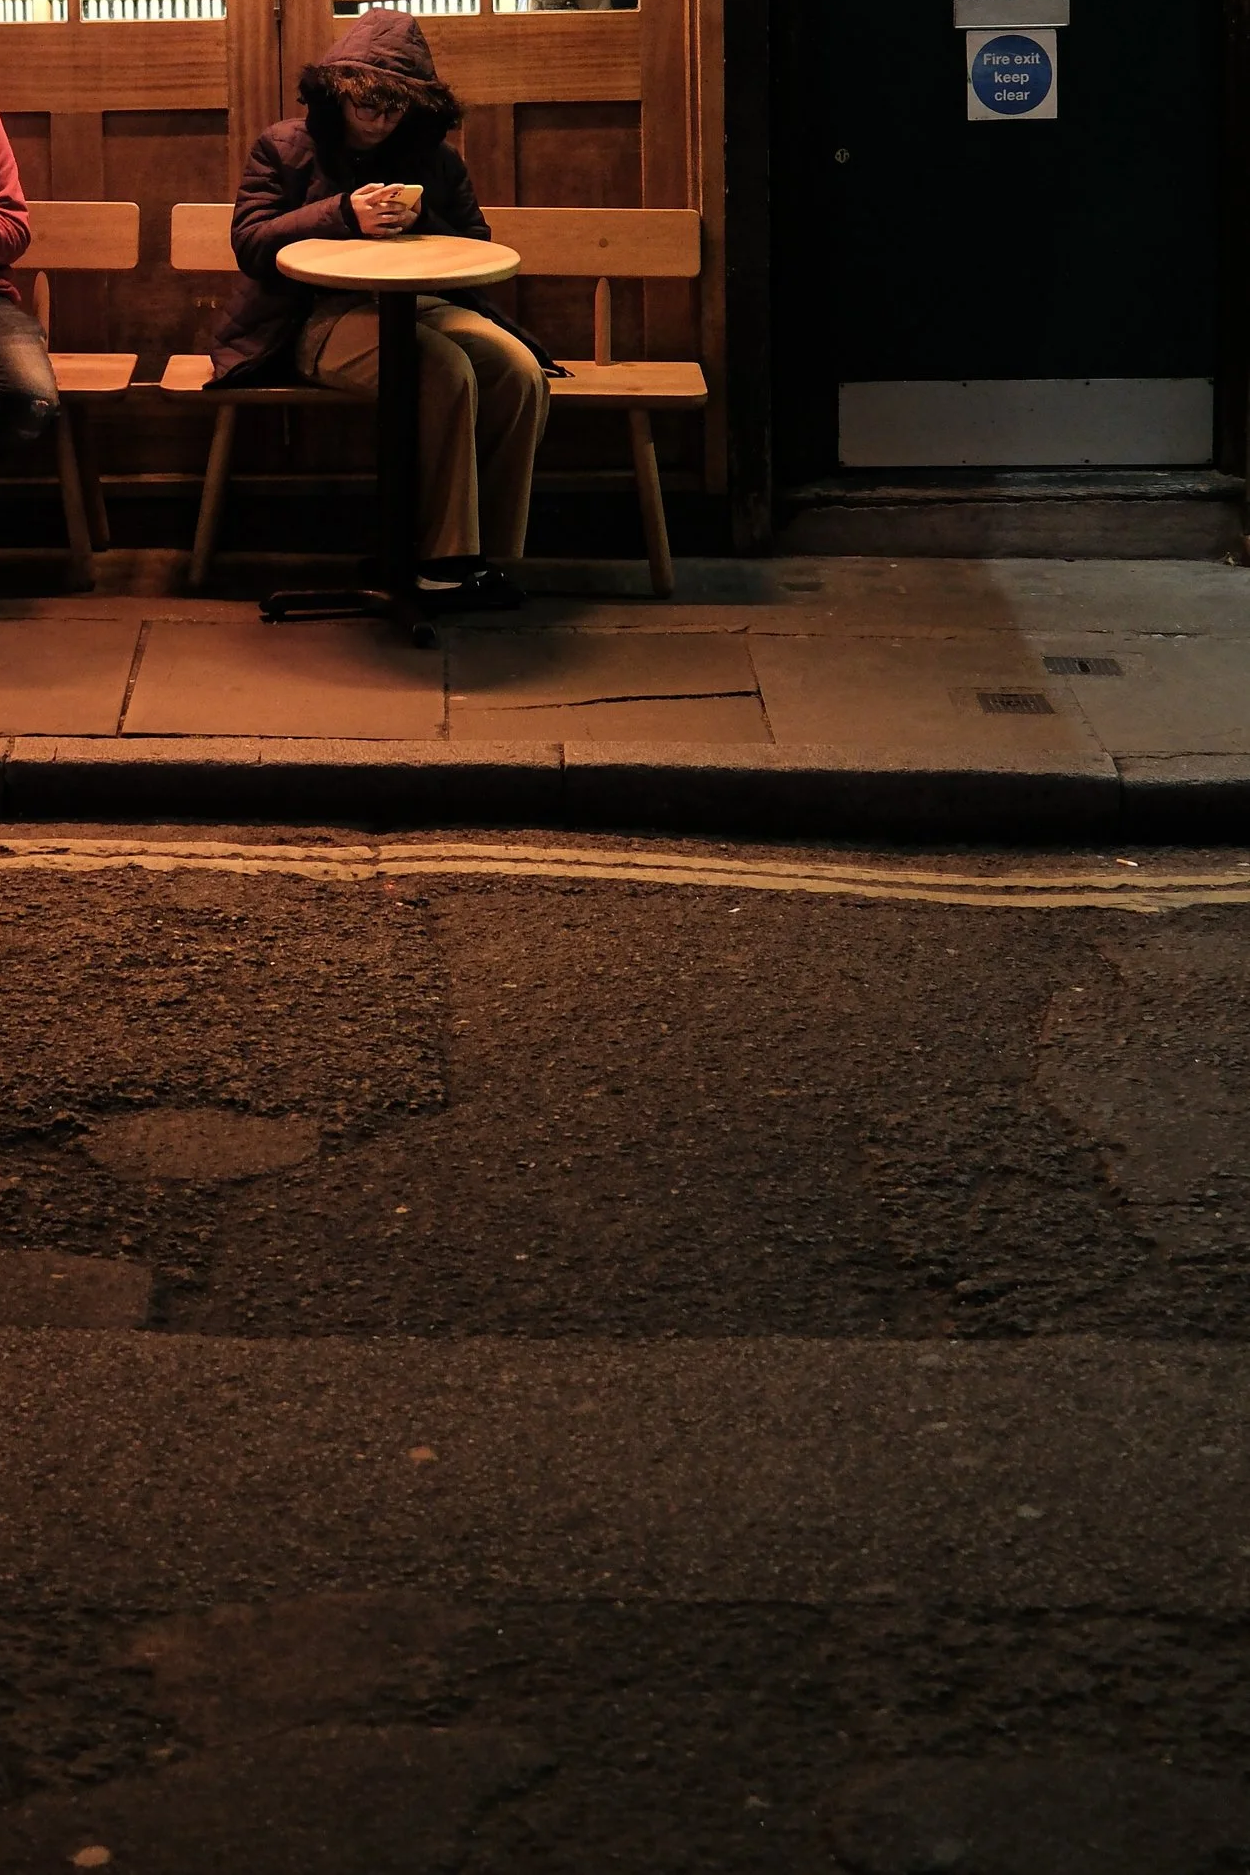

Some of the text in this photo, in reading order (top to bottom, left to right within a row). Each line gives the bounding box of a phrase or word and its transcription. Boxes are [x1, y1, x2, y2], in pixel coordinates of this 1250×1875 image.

[982, 51, 1042, 66] Fire exit
[993, 71, 1031, 86] keep
[993, 88, 1031, 102] clear
